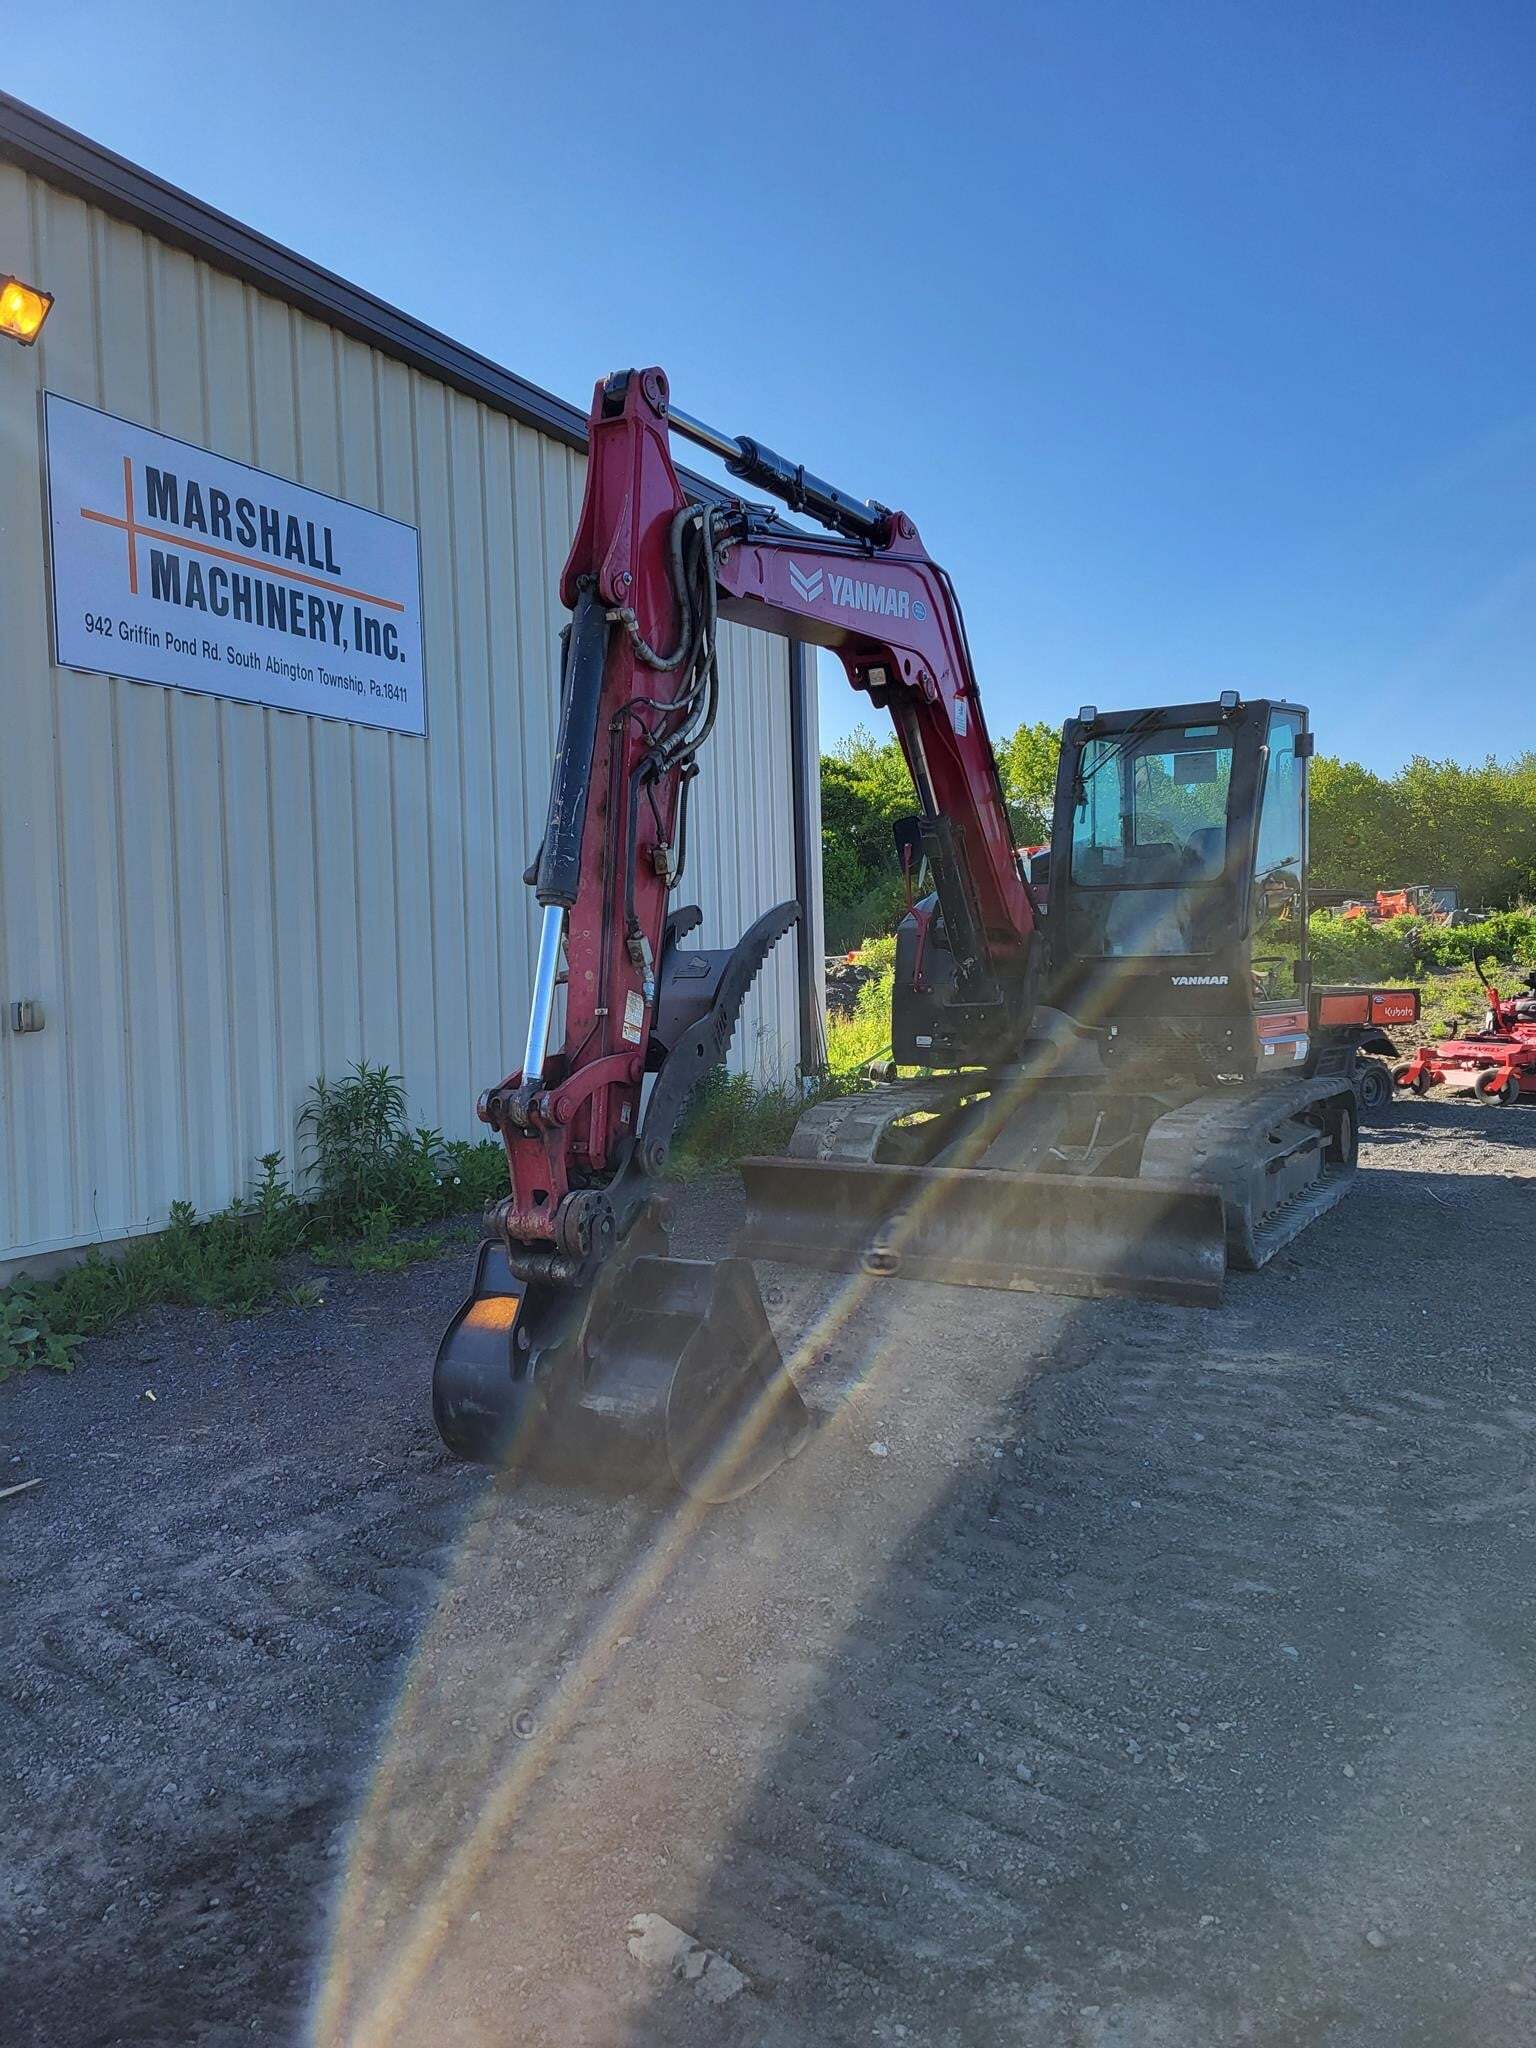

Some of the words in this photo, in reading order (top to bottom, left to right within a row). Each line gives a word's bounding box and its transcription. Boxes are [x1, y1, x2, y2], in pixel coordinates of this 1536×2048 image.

[145, 465, 342, 576] MARSHALL
[150, 548, 348, 653] MACHINERY,
[353, 606, 406, 663] Inc.
[828, 573, 910, 619] YANMAR
[84, 612, 113, 637] 942
[118, 620, 160, 648] Griffin
[165, 631, 197, 656] Pond
[202, 640, 222, 661] Rd.
[226, 646, 261, 670] South
[265, 655, 314, 682] Abington
[317, 667, 367, 697] Township,
[1171, 975, 1229, 986] YANMAR
[1384, 1006, 1413, 1017] Kubota
